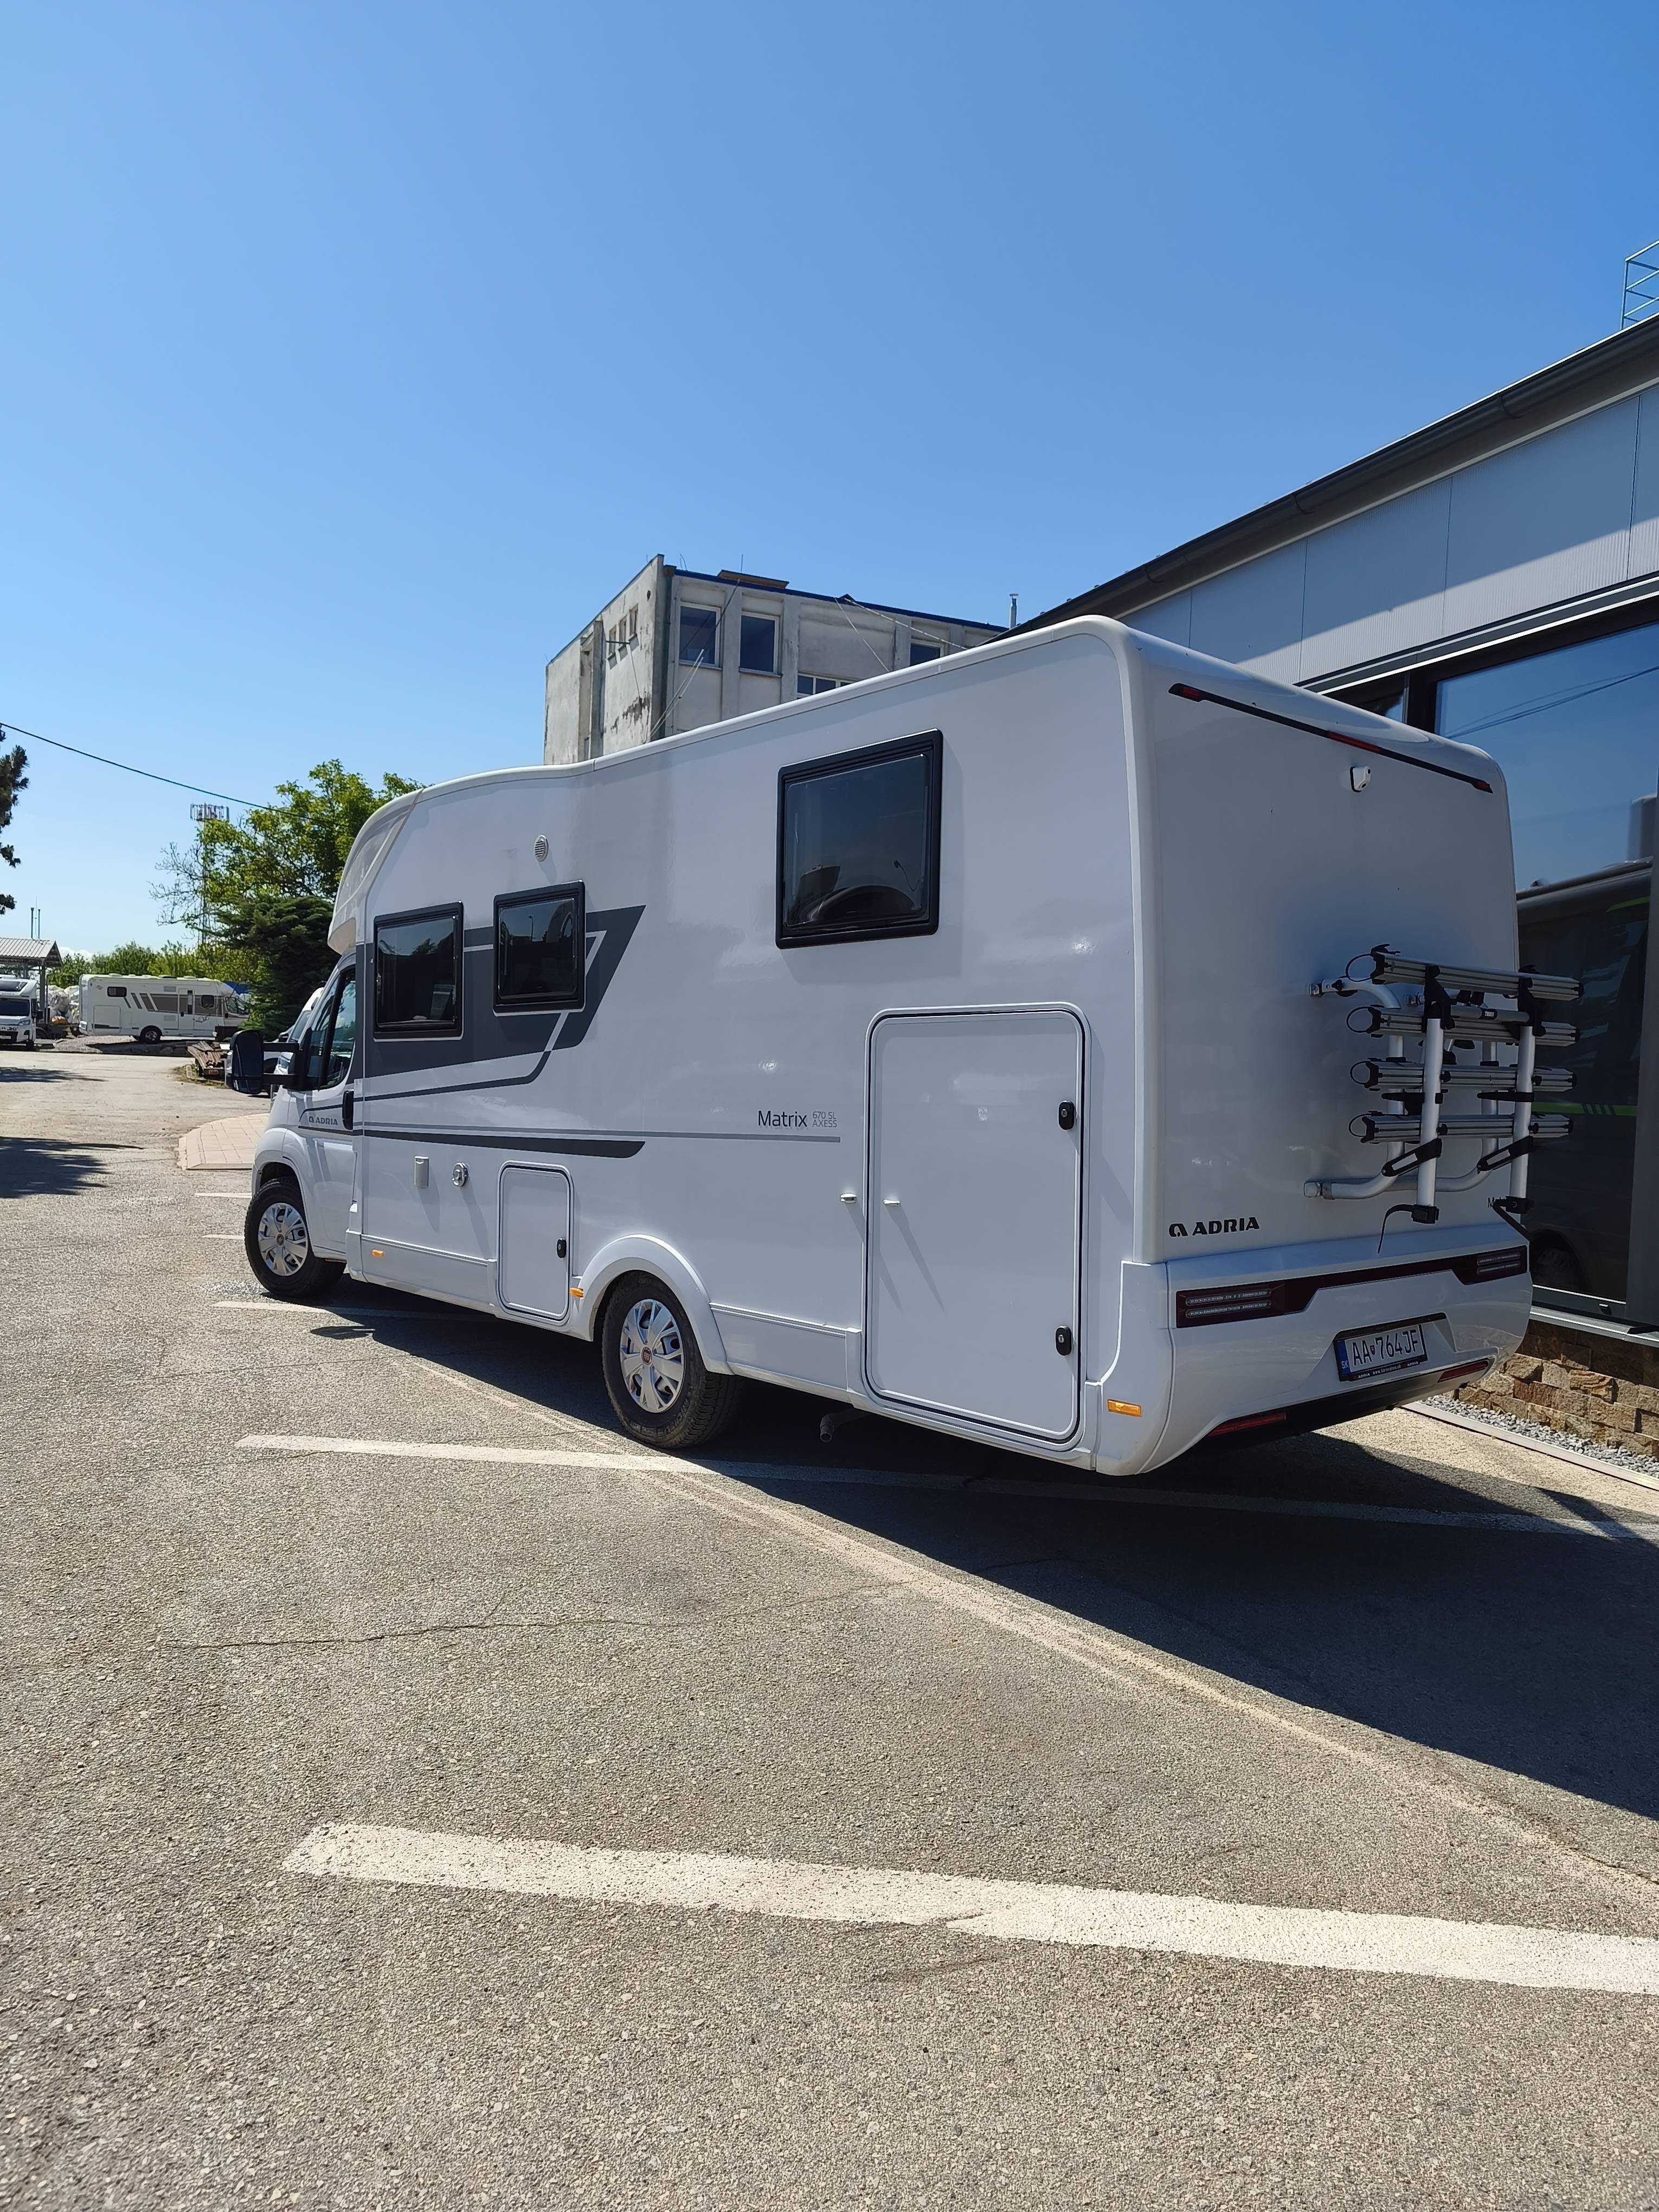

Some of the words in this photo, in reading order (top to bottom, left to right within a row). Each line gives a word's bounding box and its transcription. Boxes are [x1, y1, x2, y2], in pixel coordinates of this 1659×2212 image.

[758, 1110, 808, 1127] Matrix
[813, 1111, 826, 1120] 670
[316, 1117, 338, 1126] ADRIA
[1192, 1217, 1260, 1236] ADRIA
[1341, 1360, 1349, 1369] SK
